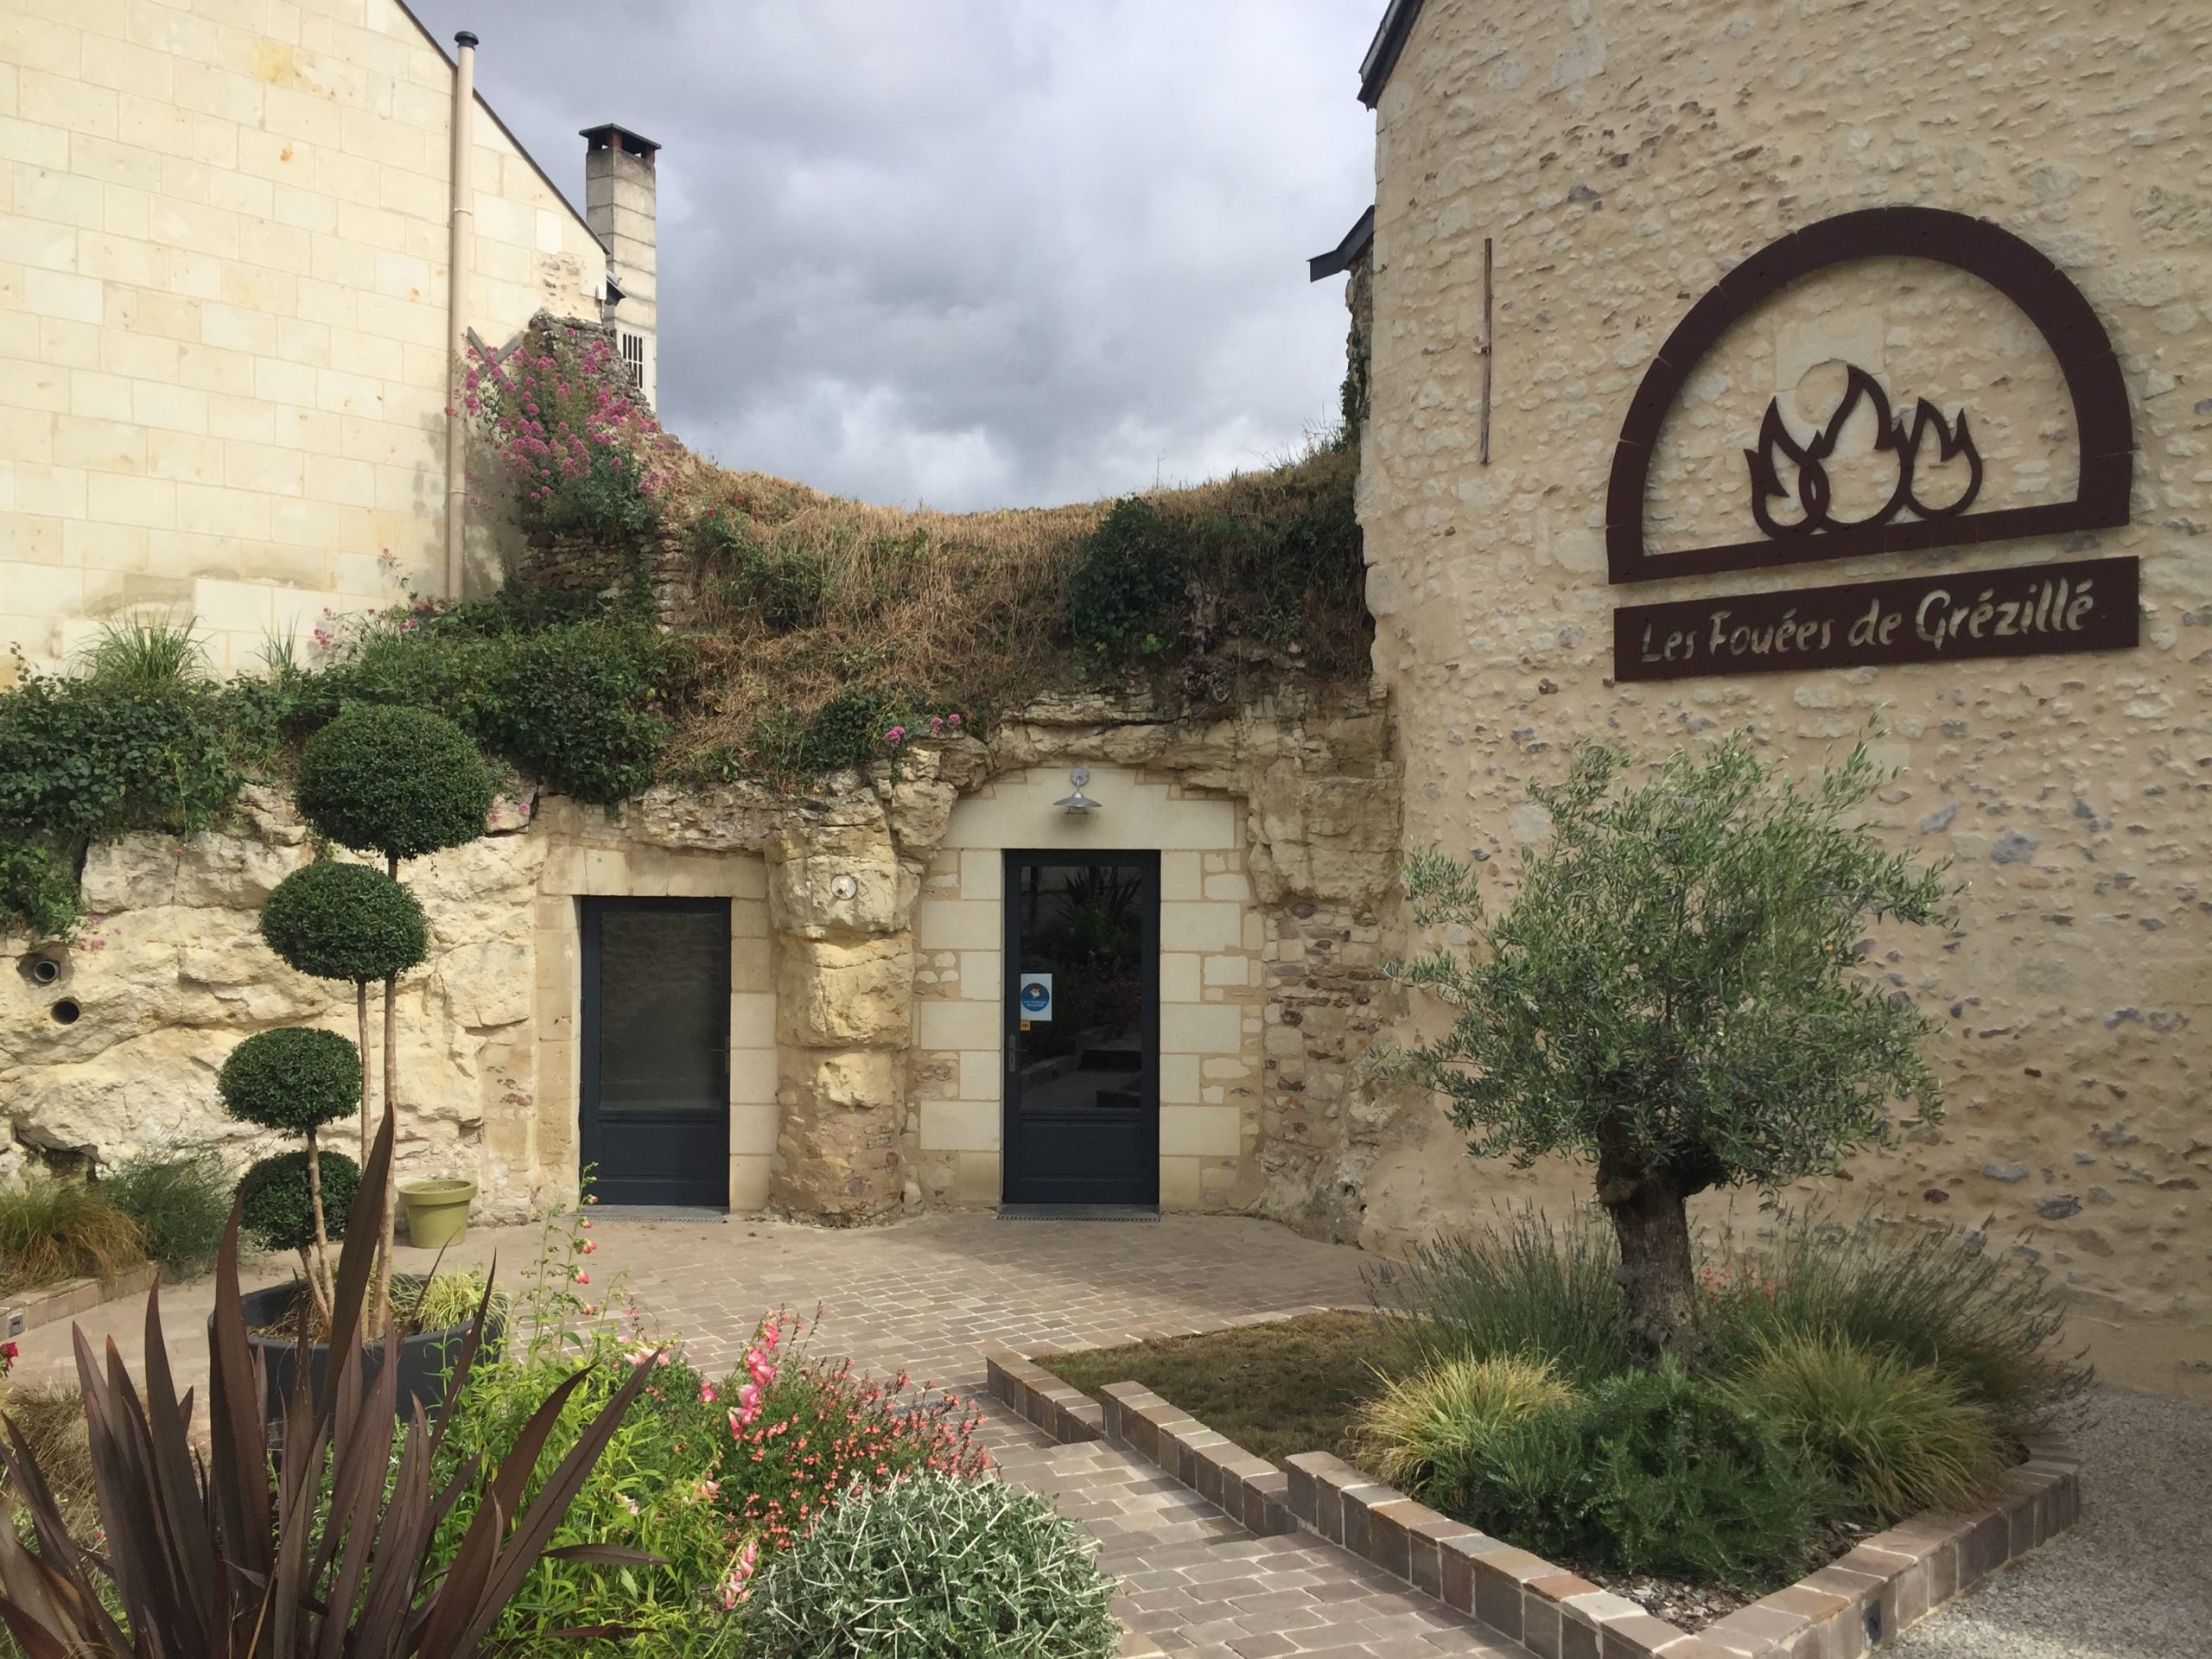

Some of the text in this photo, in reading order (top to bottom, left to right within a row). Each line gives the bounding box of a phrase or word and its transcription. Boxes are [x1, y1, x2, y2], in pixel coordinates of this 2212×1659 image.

[1641, 578, 2094, 663] Les Fouées de Grézillé
